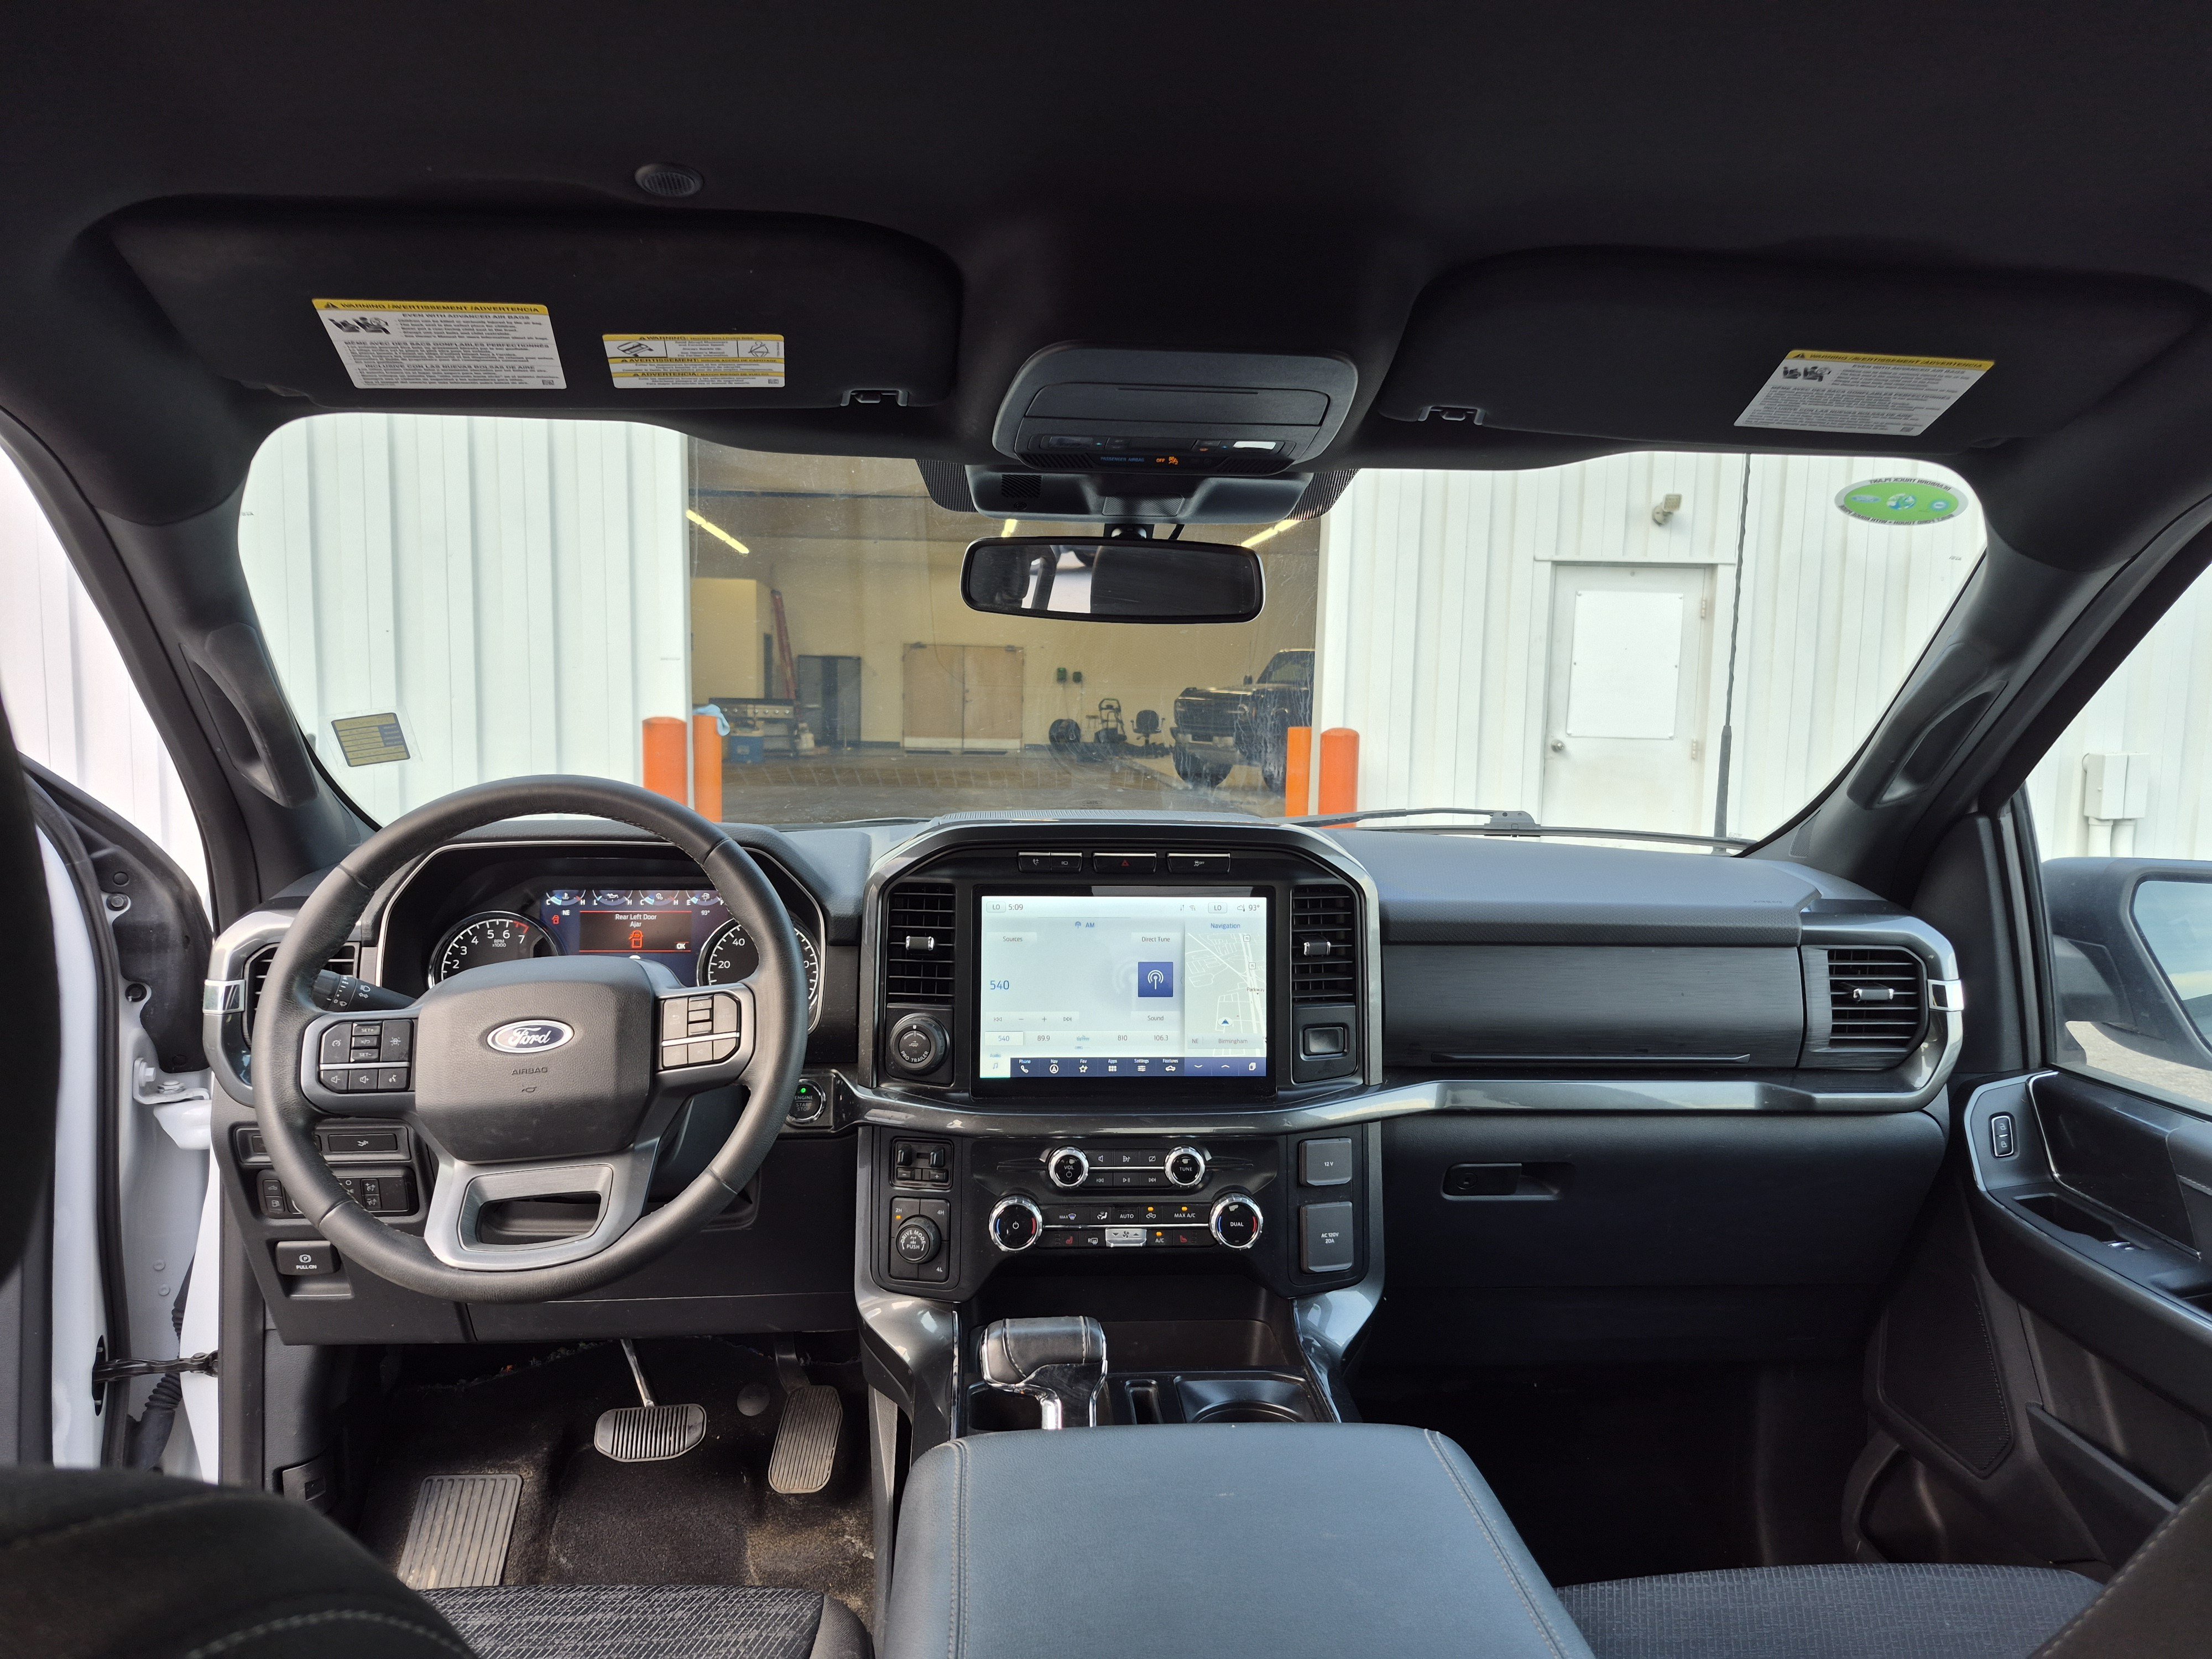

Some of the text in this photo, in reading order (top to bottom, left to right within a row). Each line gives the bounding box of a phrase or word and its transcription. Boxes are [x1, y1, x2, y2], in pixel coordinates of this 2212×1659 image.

[487, 930, 494, 939] 5
[503, 930, 510, 939] 6
[471, 936, 479, 945] 4
[518, 935, 525, 945] 7
[732, 938, 745, 946] 40
[460, 946, 467, 955] 3
[452, 959, 460, 969] 2
[718, 960, 731, 969] 20
[990, 979, 1010, 990] 540
[508, 1027, 552, 1047] Ford
[900, 1050, 930, 1063] PRO TRAILER
[511, 1067, 548, 1075] AIRBAG
[900, 1229, 926, 1245] DRIVE MODE
